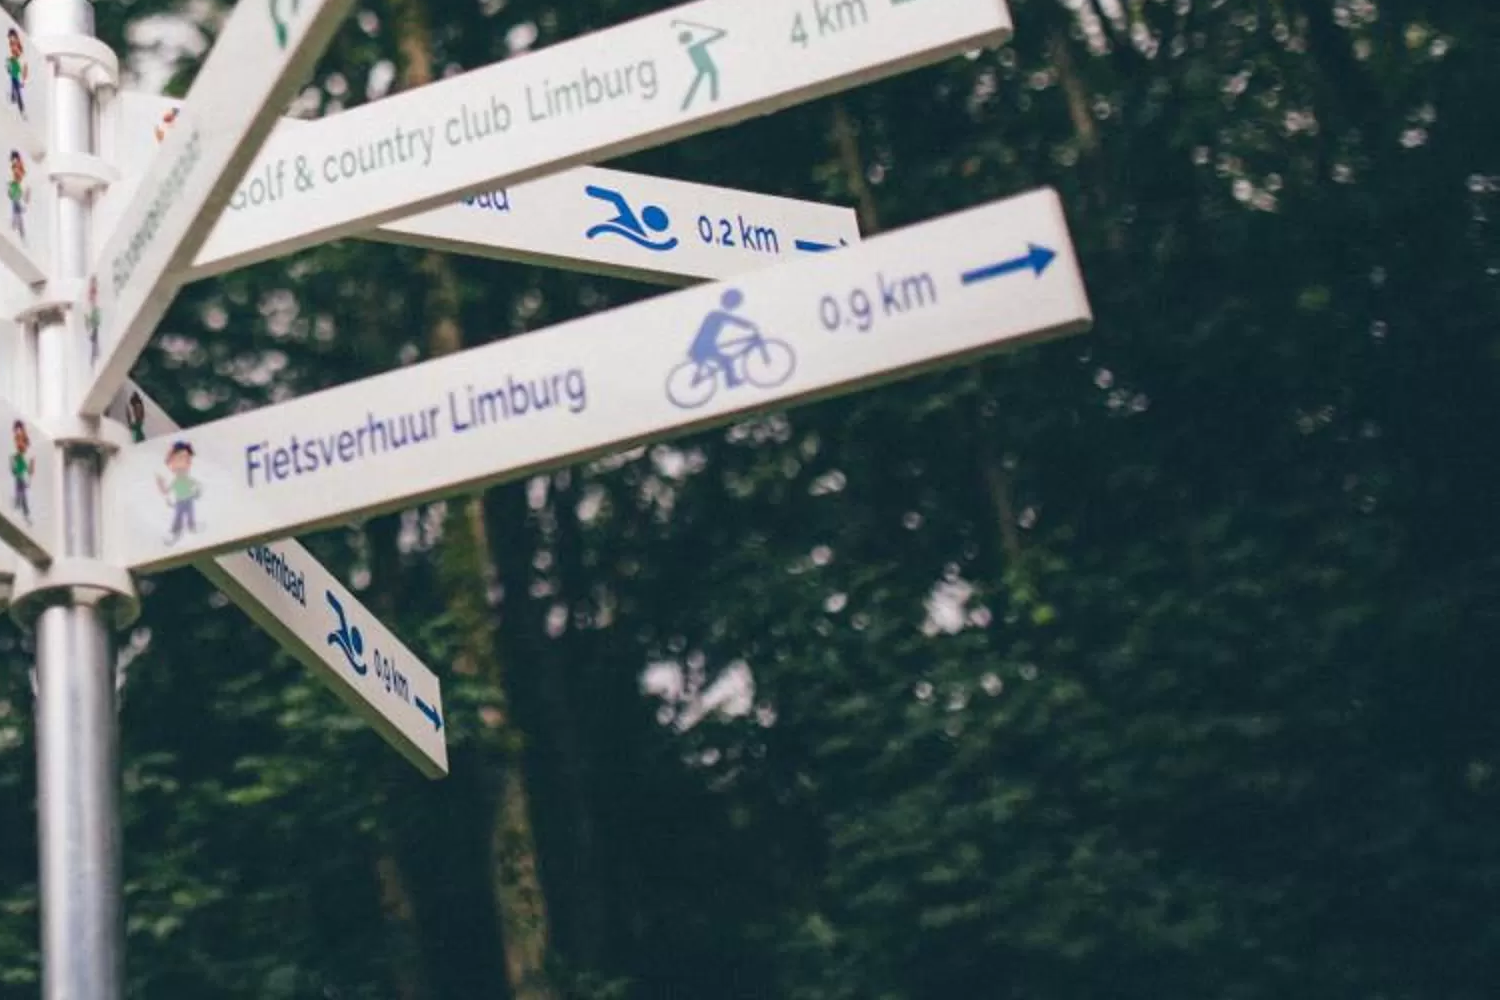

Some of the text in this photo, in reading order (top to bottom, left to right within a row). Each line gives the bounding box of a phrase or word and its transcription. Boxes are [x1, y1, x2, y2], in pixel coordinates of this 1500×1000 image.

[791, 10, 809, 50] 4
[294, 154, 314, 193] &
[323, 124, 434, 184] country
[445, 94, 512, 146] club
[525, 58, 659, 122] Limburg
[698, 214, 779, 254] 0.2 km
[819, 270, 938, 334] 0.9 km
[245, 367, 589, 488] Fietsverhuur Limburg
[392, 657, 411, 704] km
